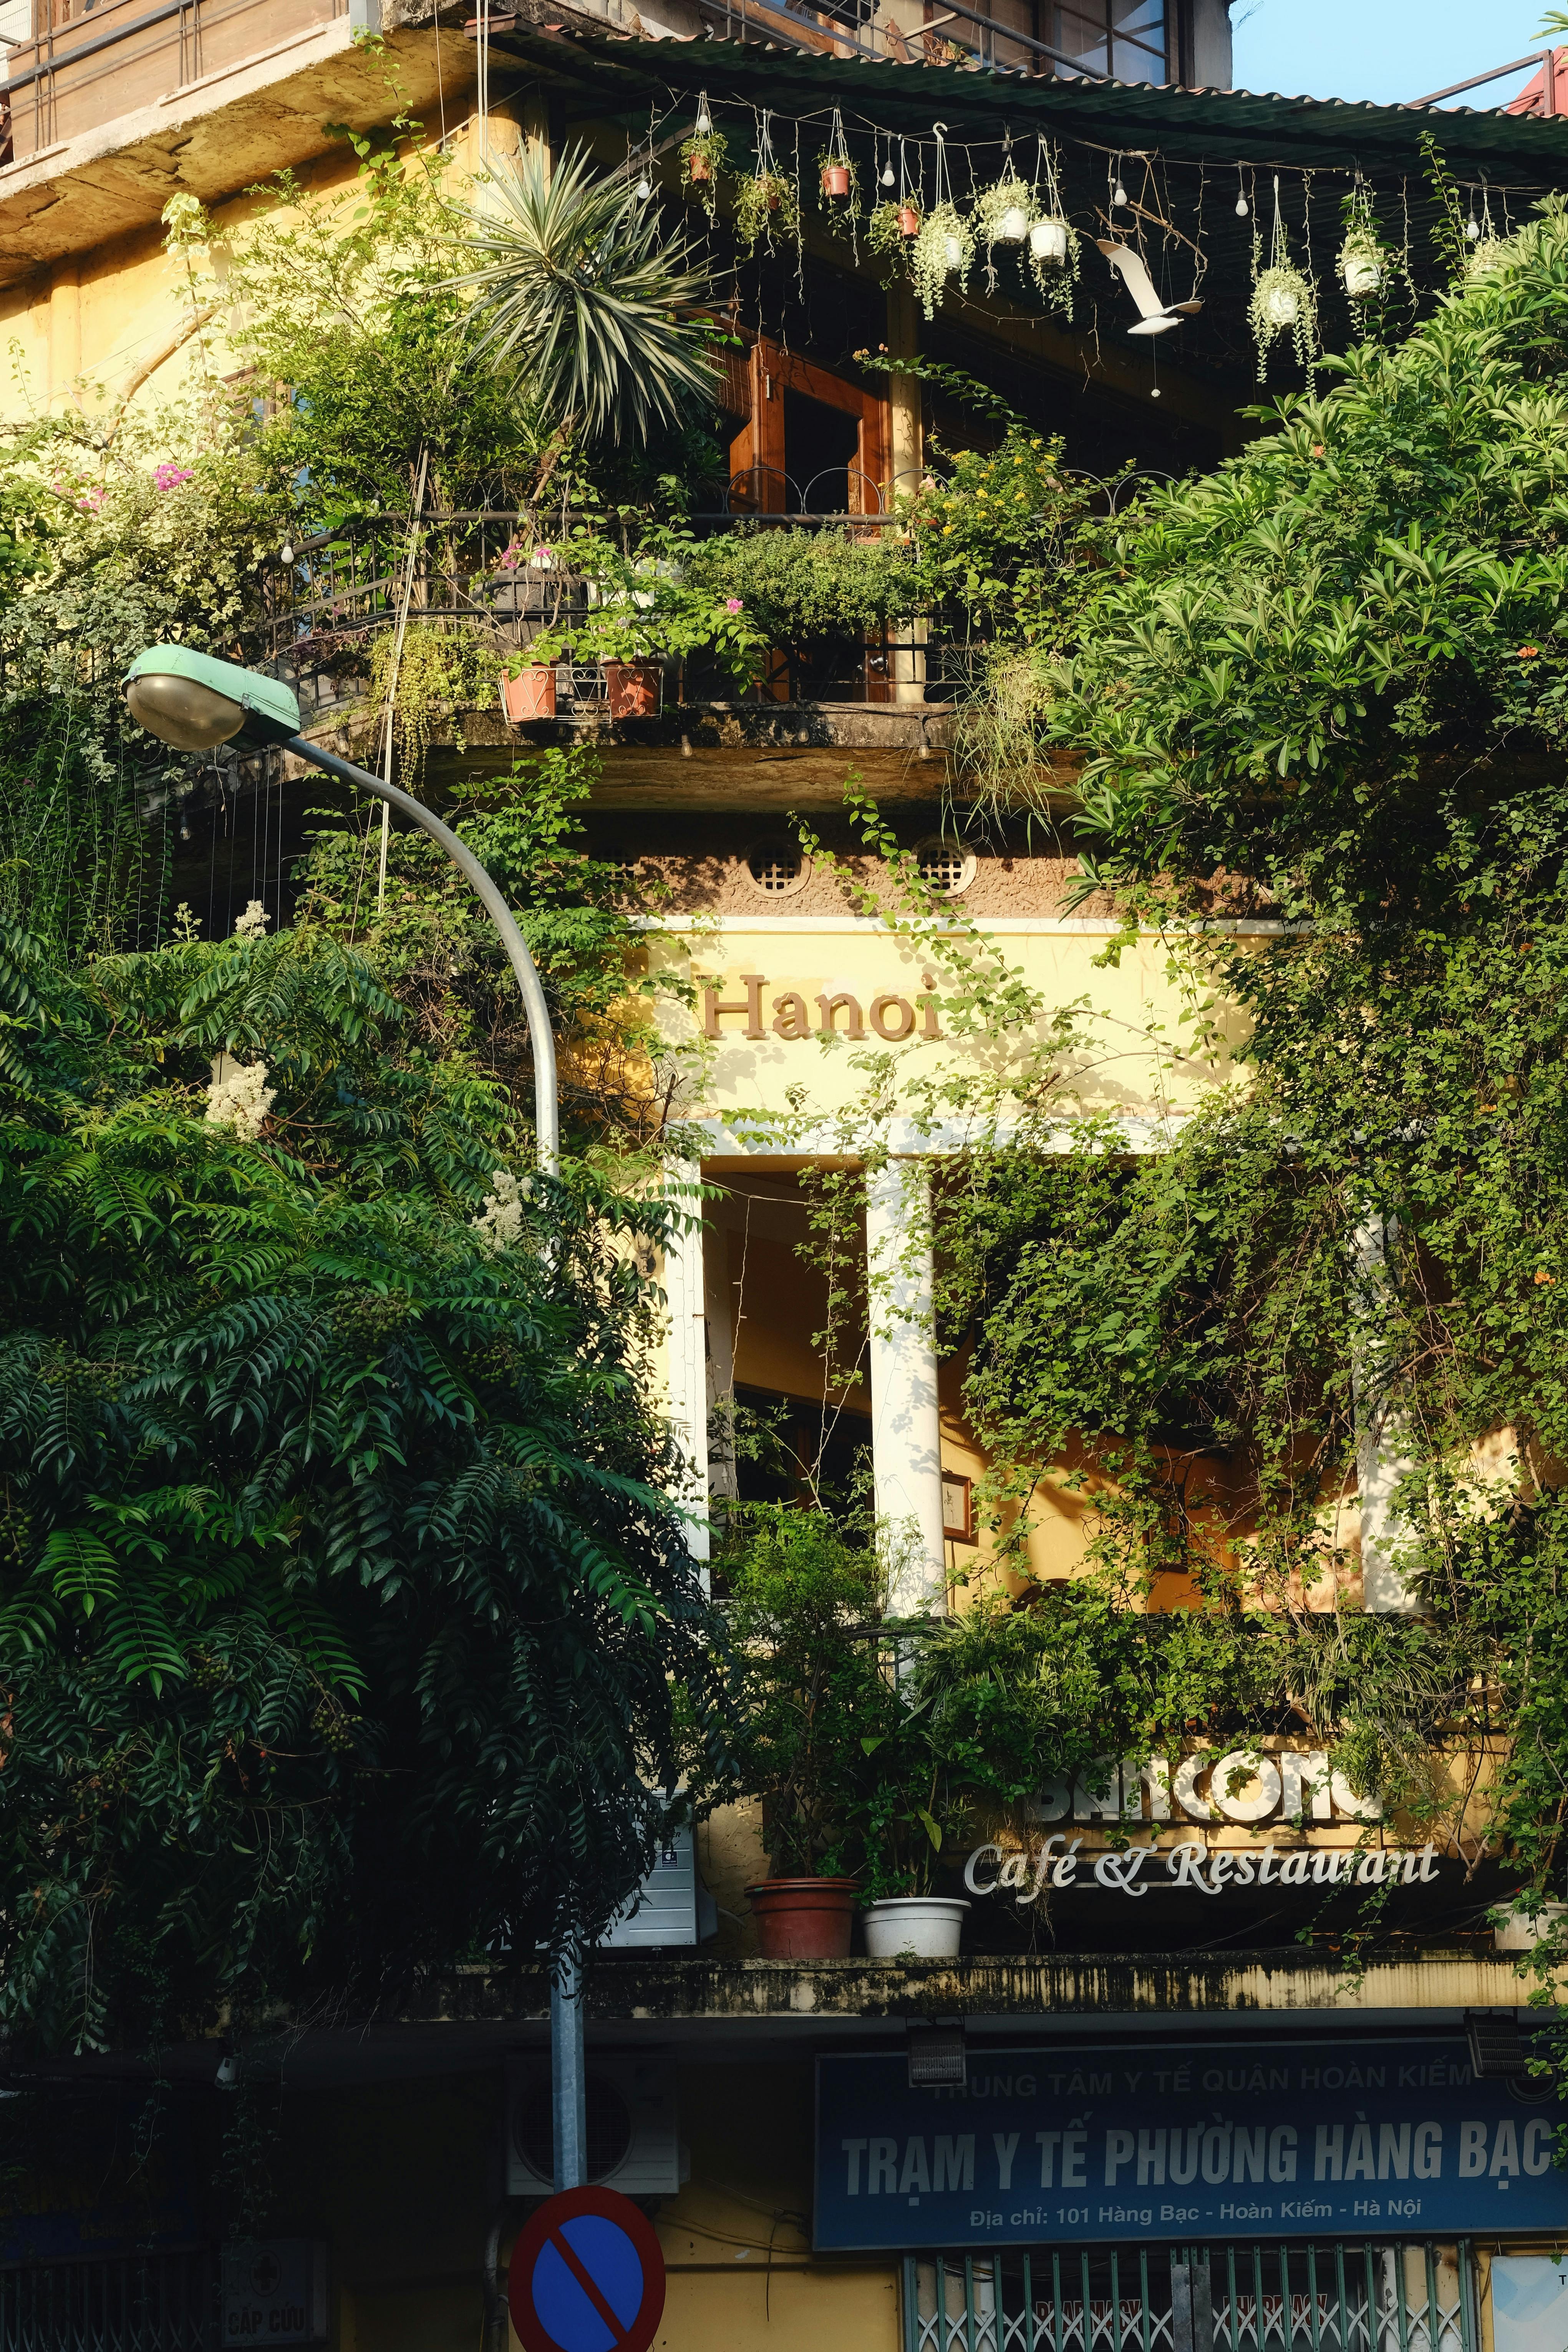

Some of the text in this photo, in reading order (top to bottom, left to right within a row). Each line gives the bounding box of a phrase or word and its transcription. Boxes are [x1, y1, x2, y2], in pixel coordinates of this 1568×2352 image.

[696, 974, 943, 1038] Hanoi
[964, 1834, 1440, 1904] Café & Restaurant
[1048, 2068, 1112, 2096] TÂM
[1125, 2072, 1142, 2092] Y
[1153, 2060, 1192, 2092] TẾ
[1202, 2064, 1288, 2095] QUẬN
[1301, 2060, 1385, 2090] HOÀN
[1398, 2055, 1472, 2087] KIẾM
[842, 2111, 1552, 2206] TRẠM Y TẾ PHƯỜNG HÀNG BẠC
[970, 2210, 1003, 2229] Địa
[1010, 2206, 1048, 2225] chỉ:
[1056, 2207, 1089, 2224] 101
[1099, 2206, 1152, 2225] Hàng
[1160, 2205, 1199, 2224] Bạc
[1220, 2203, 1272, 2219] Hoàn
[1281, 2199, 1332, 2218] Kiếm
[1354, 2200, 1380, 2216] Hà
[1387, 2199, 1421, 2218] Nội
